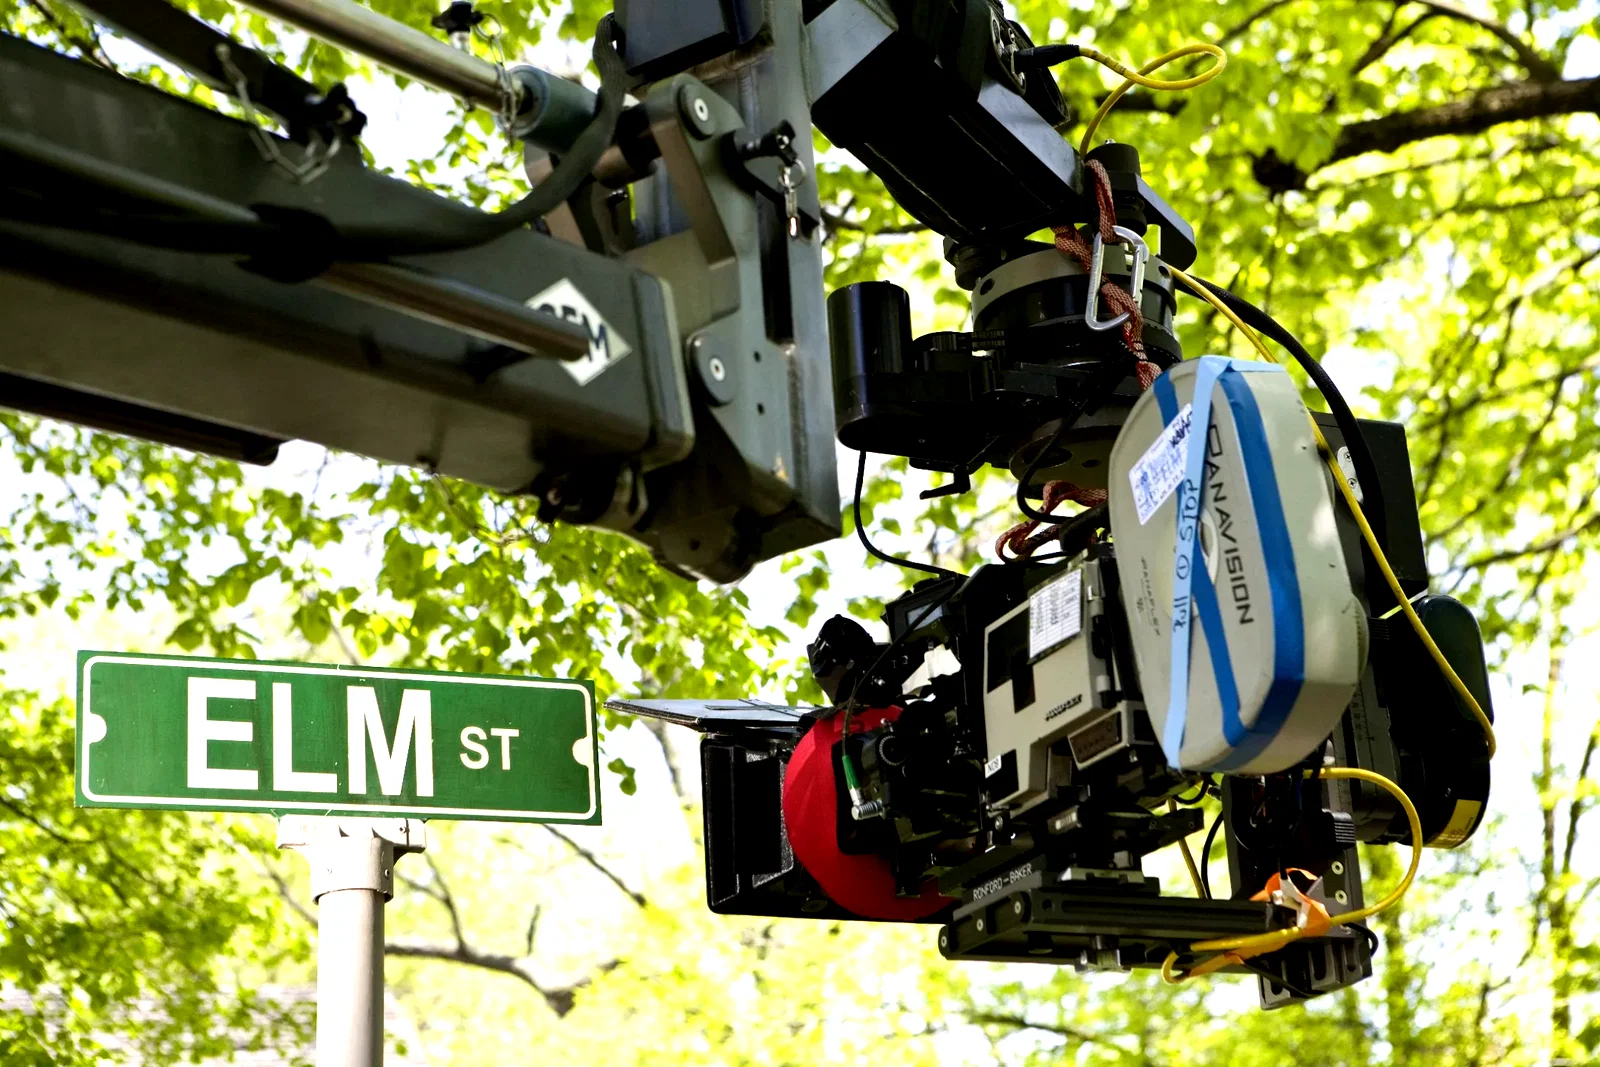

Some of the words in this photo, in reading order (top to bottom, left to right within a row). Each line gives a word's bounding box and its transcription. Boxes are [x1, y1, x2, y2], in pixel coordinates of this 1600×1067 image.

[1180, 478, 1200, 543] STOP
[187, 677, 434, 797] ELM
[460, 725, 520, 771] ST
